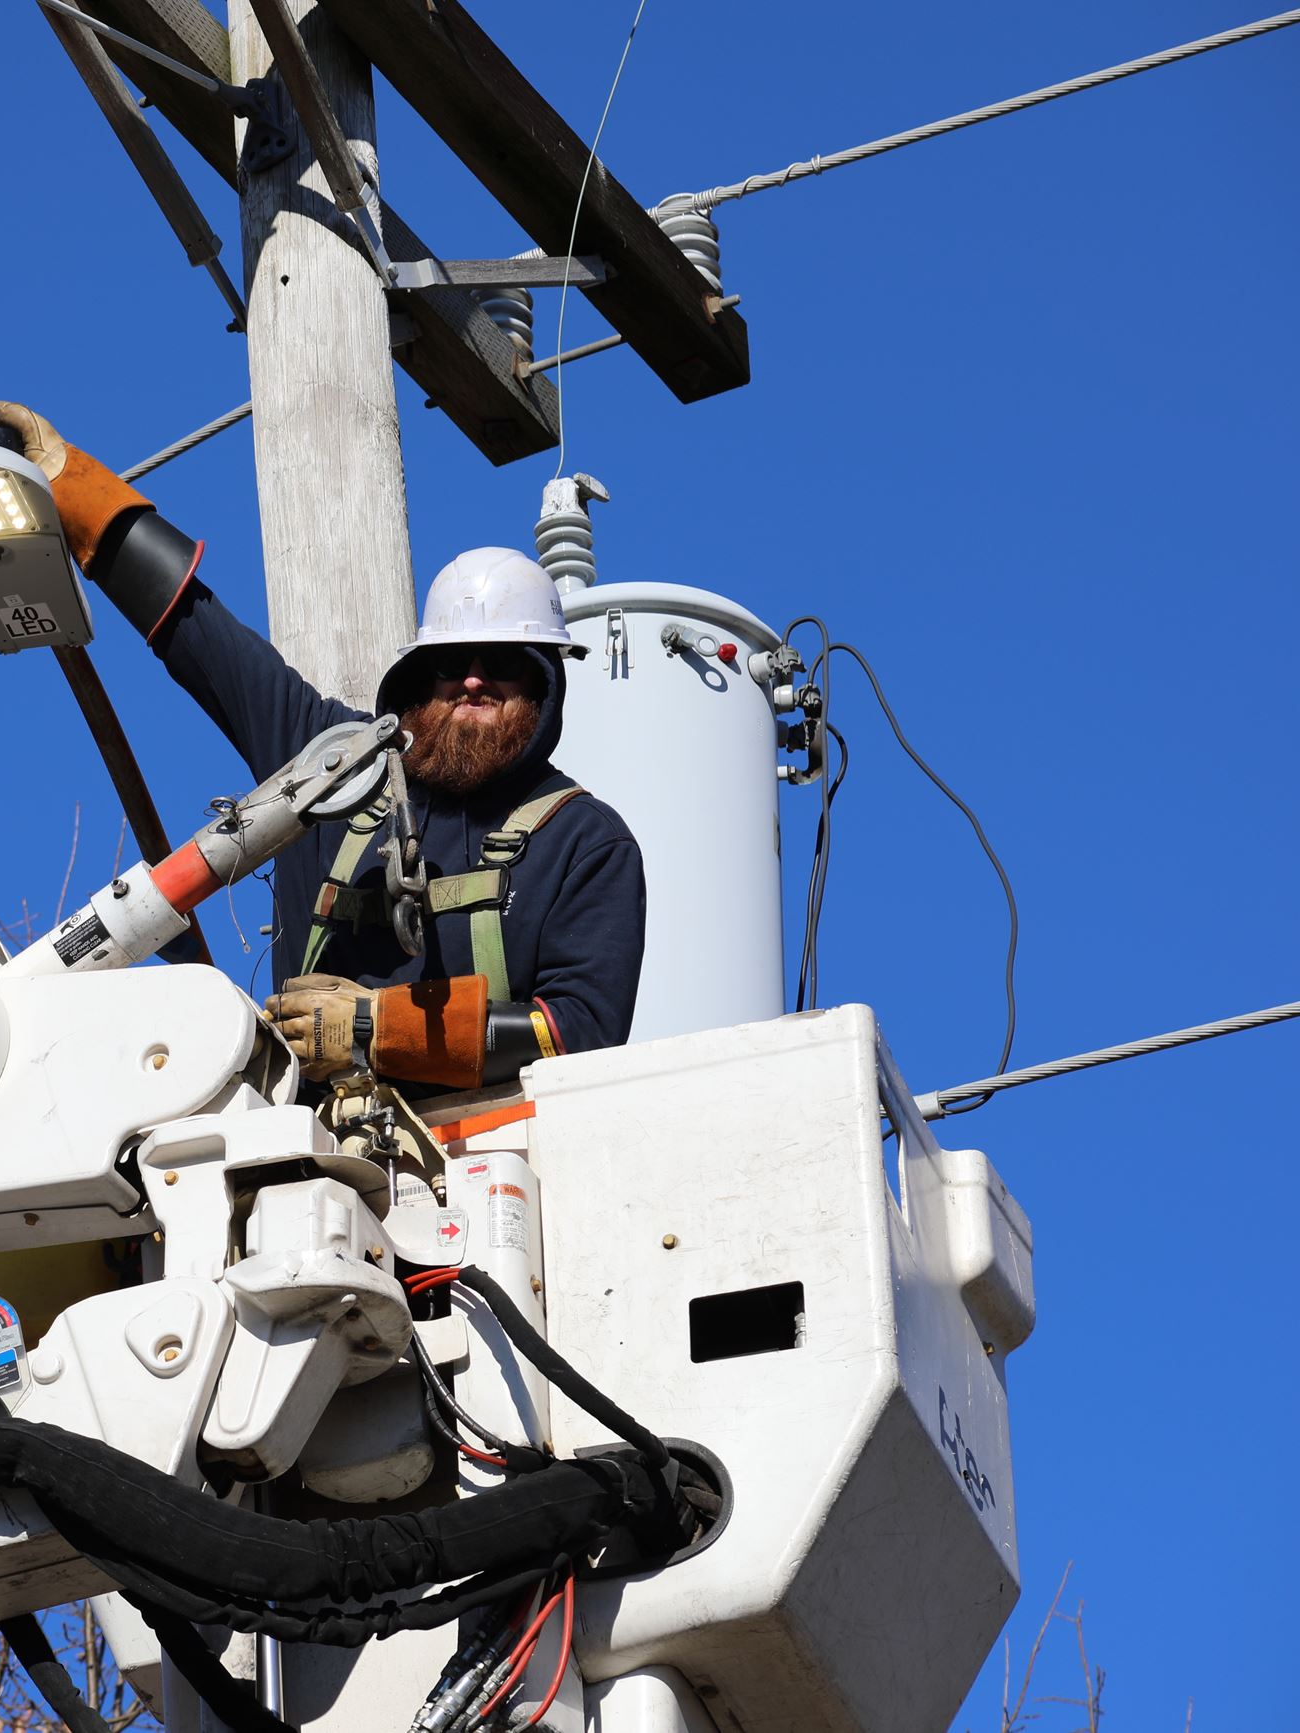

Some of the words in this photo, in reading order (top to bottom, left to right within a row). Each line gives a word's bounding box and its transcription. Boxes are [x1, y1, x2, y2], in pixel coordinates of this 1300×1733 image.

[12, 606, 38, 621] 40
[6, 619, 57, 637] LED
[88, 933, 99, 942] AND
[313, 1007, 323, 1061] YOUNGSTOWN
